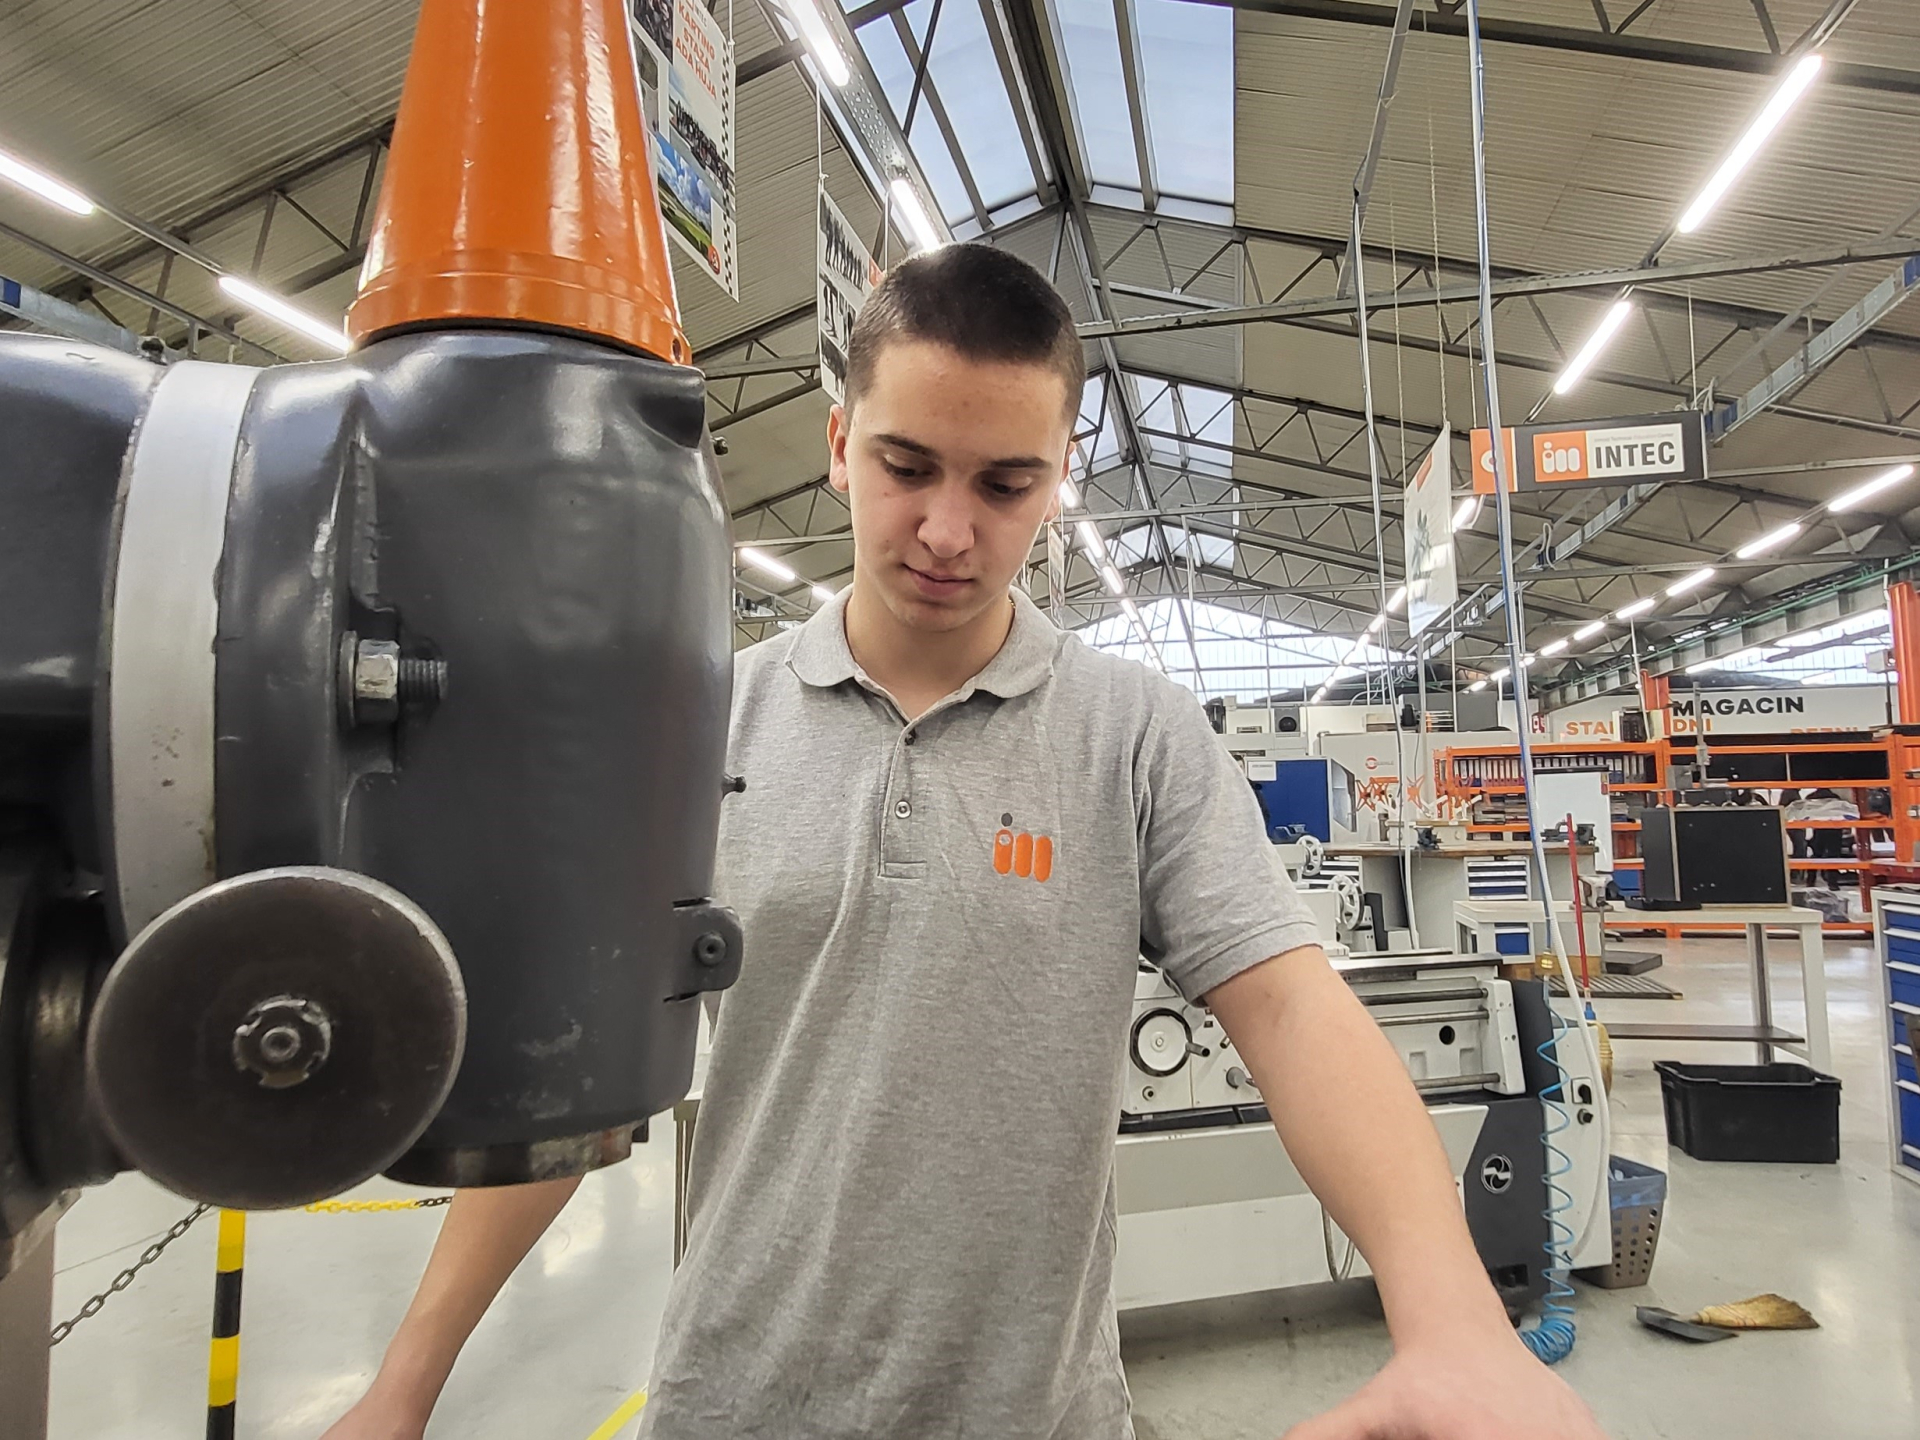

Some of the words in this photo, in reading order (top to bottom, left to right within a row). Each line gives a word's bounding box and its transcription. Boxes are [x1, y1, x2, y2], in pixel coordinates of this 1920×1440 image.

[678, 1, 715, 61] KARTING
[683, 27, 711, 73] STAZA
[675, 36, 694, 69] ADA
[695, 63, 717, 100] HUJA
[1595, 441, 1676, 469] INTEC
[1673, 696, 1804, 716] MAGACIN
